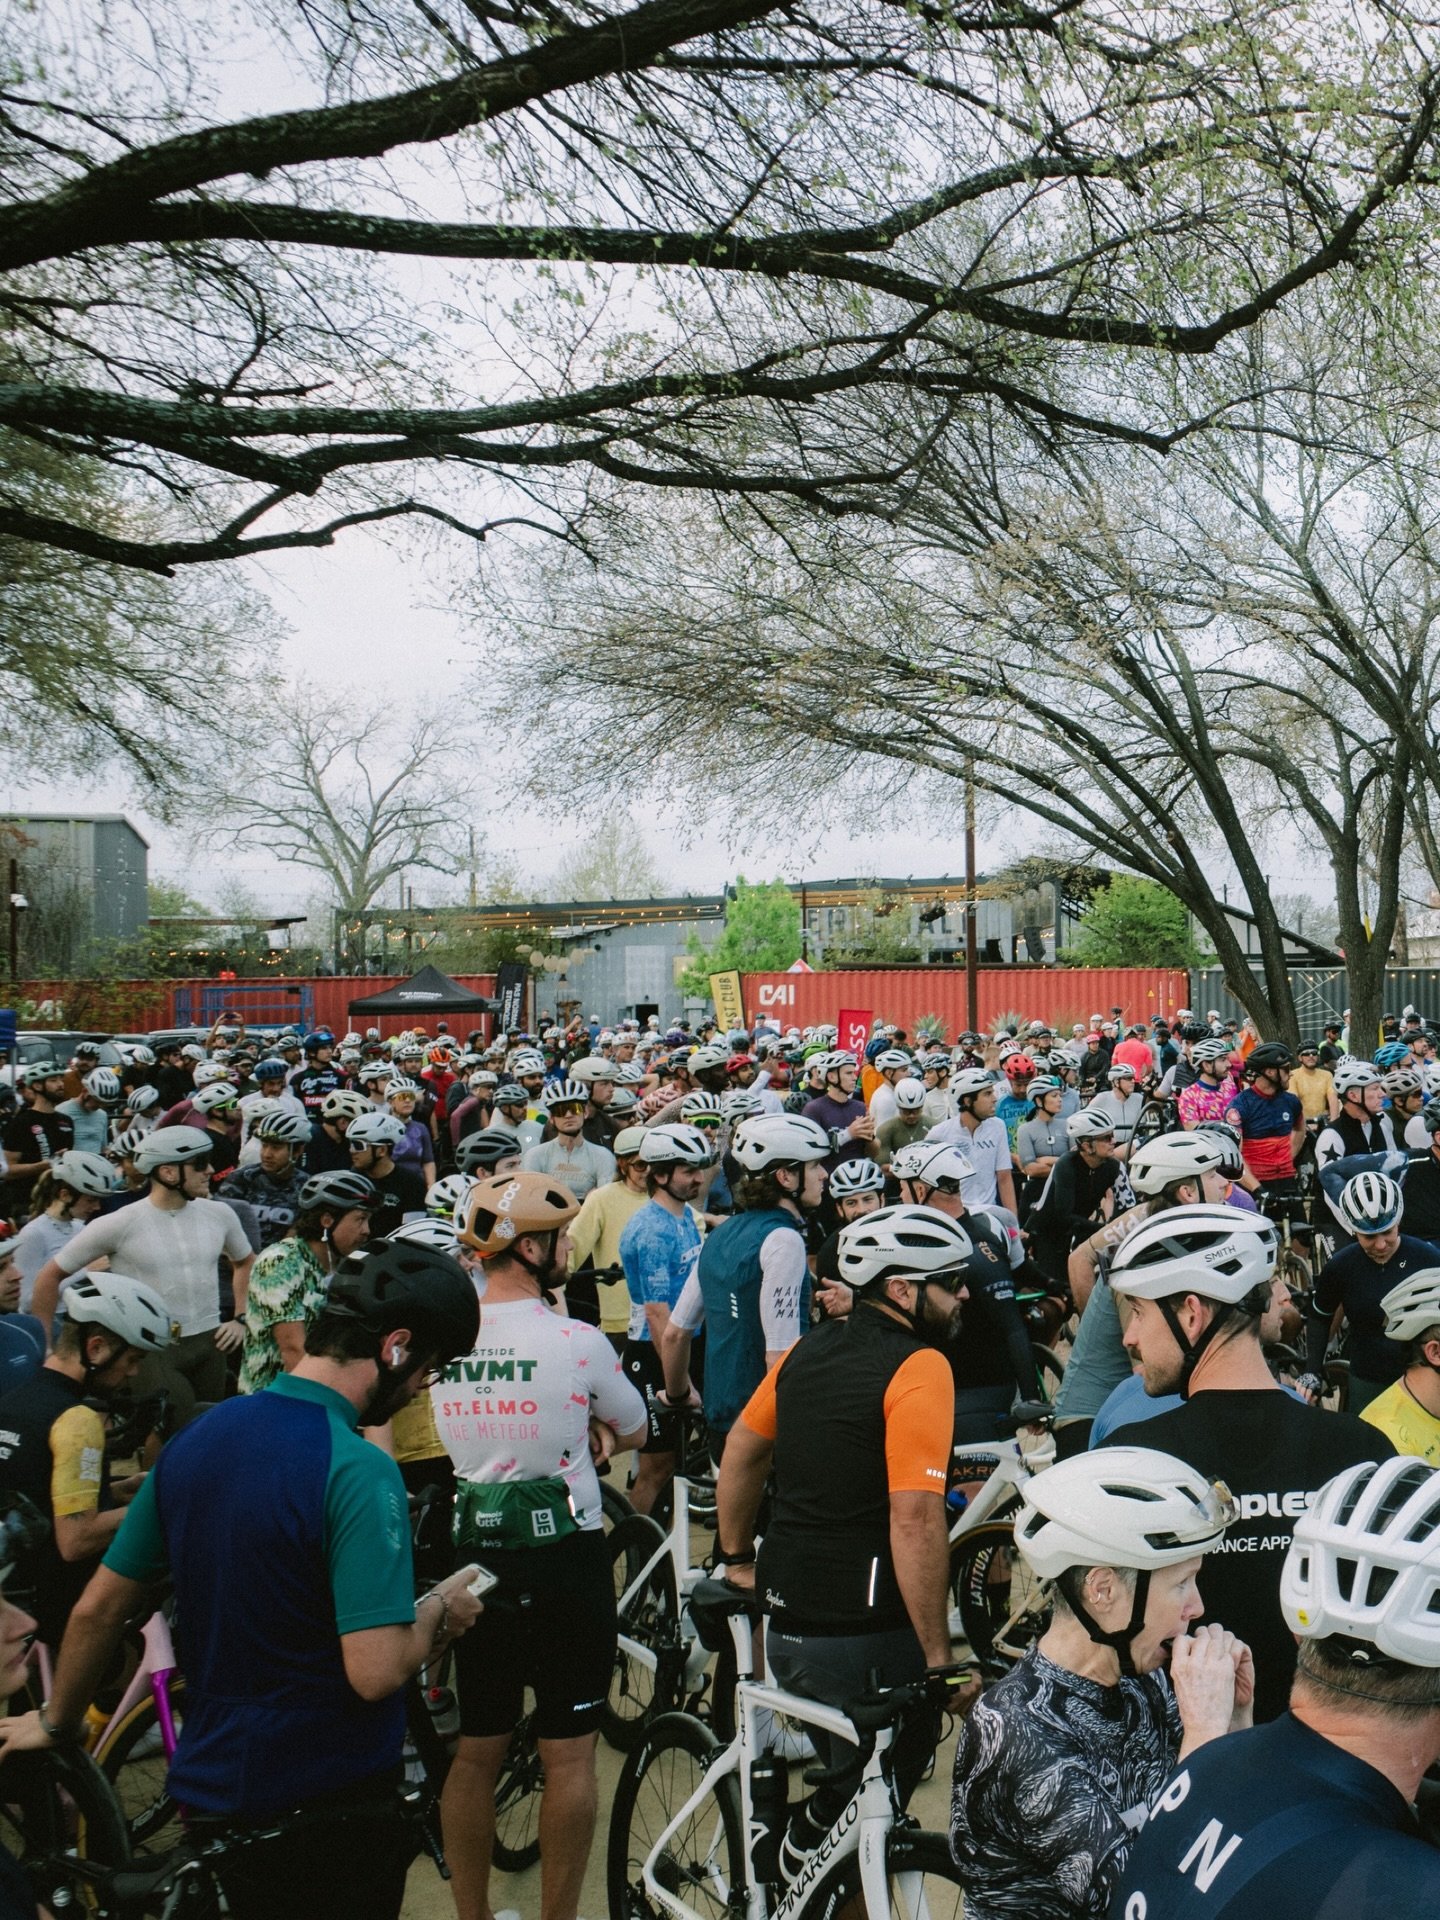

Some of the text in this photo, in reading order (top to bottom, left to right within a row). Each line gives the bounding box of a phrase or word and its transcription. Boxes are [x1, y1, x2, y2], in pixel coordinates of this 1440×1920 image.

[718, 977, 734, 1002] CLUB
[759, 984, 796, 1006] CAI
[1204, 1244, 1237, 1263] SMITH
[440, 1359, 538, 1384] MVMT
[475, 1385, 496, 1395] CO.
[1149, 1768, 1244, 1895] P N
[775, 1799, 859, 1920] PINARELLO
